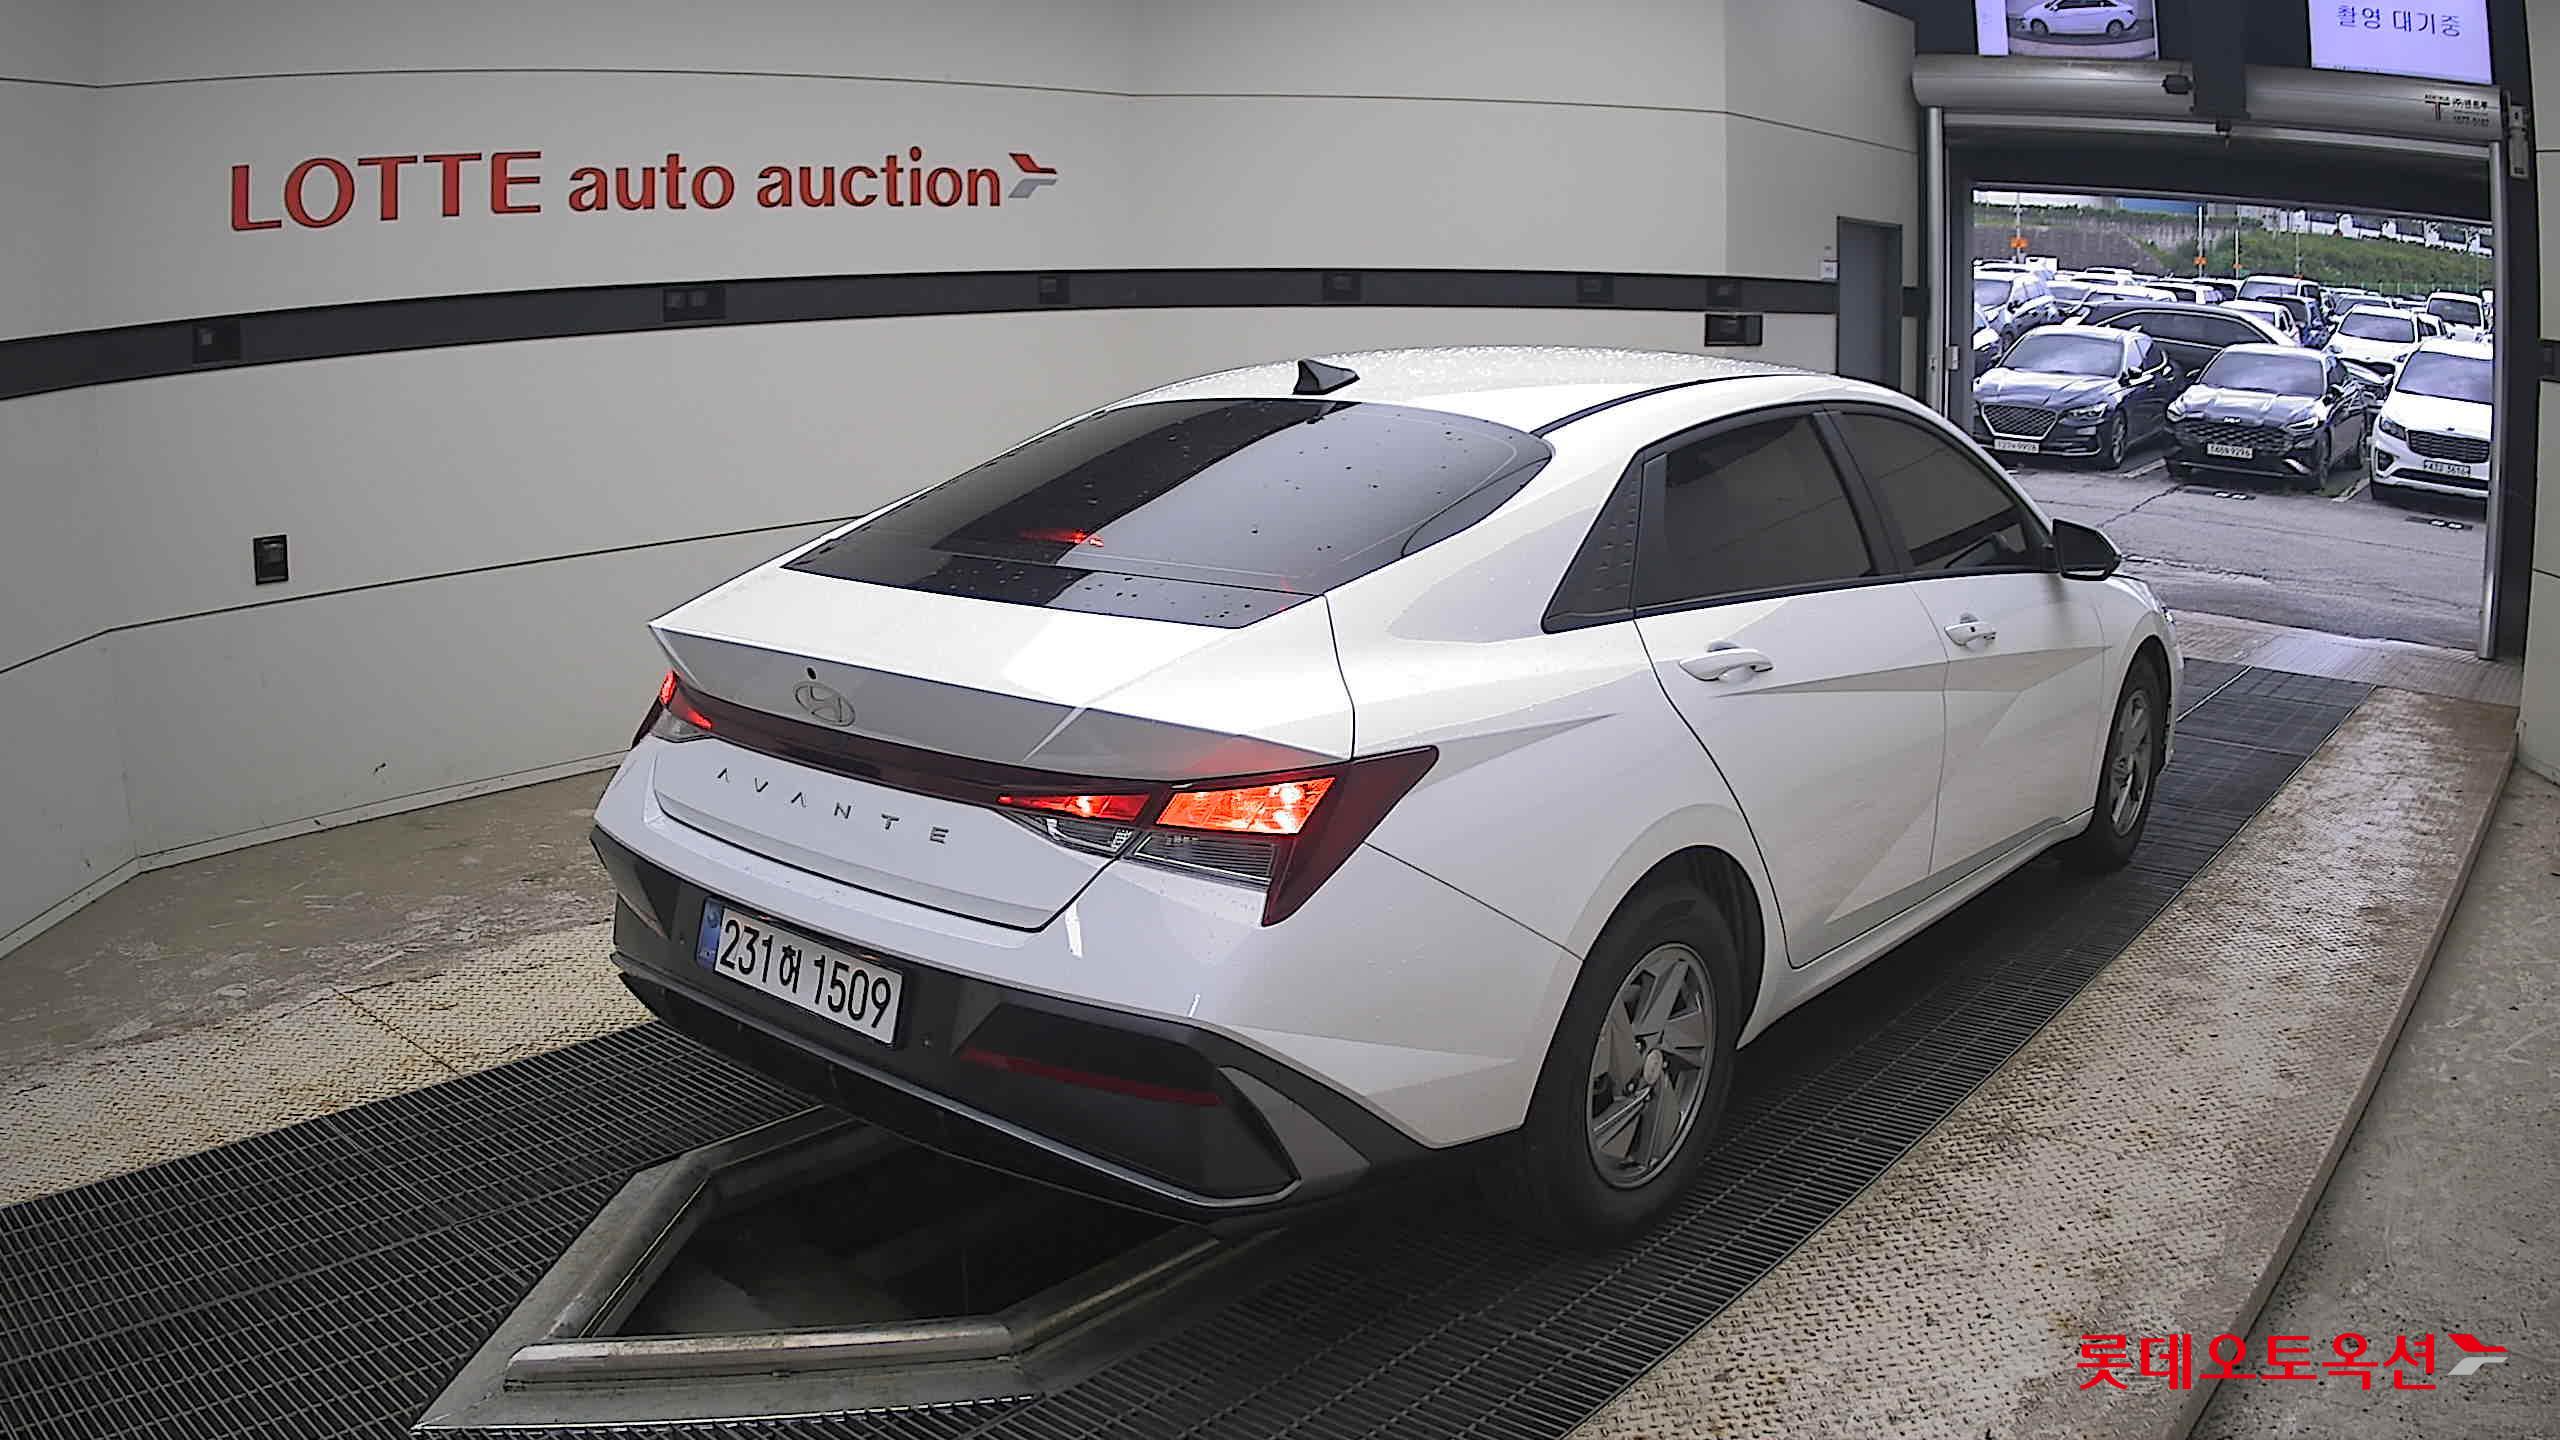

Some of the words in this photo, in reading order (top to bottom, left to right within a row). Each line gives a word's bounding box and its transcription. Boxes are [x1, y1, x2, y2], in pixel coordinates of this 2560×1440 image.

[2393, 11, 2460, 37] 대기중
[231, 151, 542, 231] LOTTE
[568, 153, 735, 212] auto
[756, 146, 1001, 208] auction
[717, 767, 949, 844] AVANTE
[720, 919, 802, 994] 231허
[814, 955, 891, 1028] 1509
